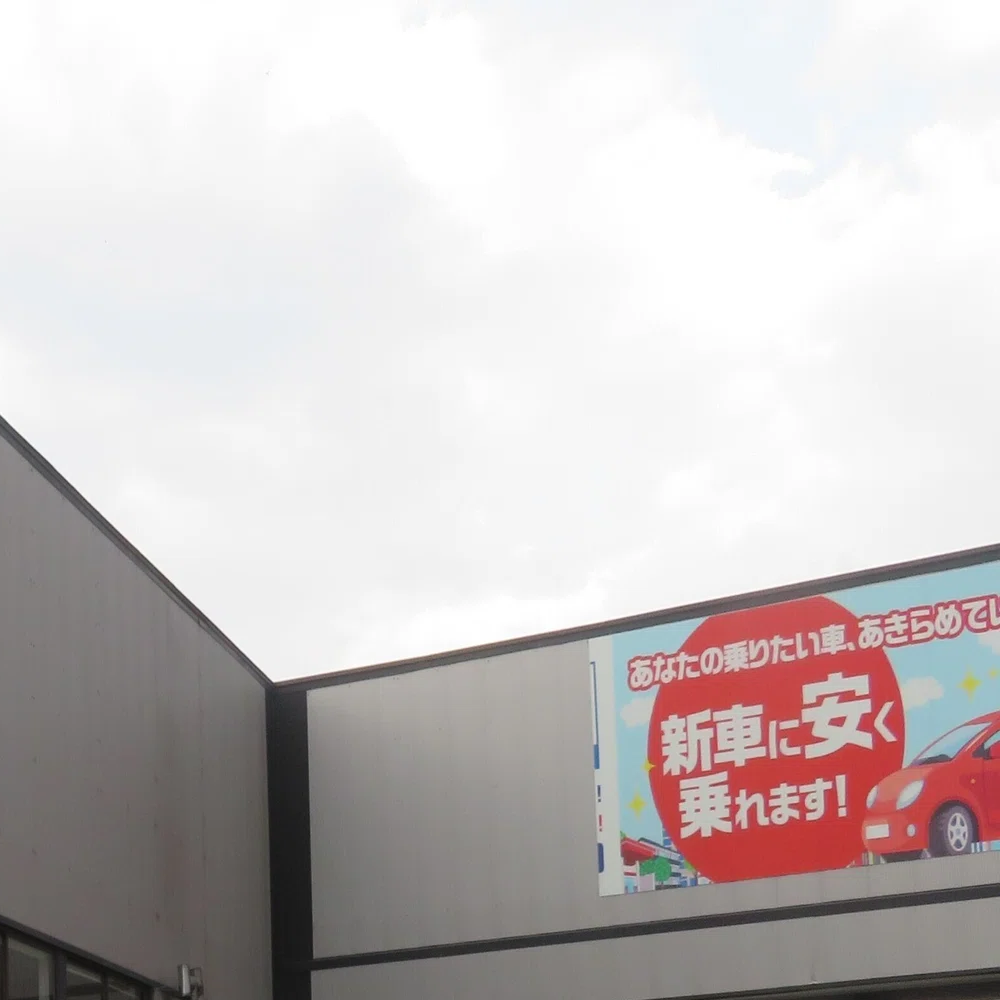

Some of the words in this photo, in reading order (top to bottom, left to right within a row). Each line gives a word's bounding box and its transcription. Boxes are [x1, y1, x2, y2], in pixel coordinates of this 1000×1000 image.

[661, 672, 898, 776] 新車に安く
